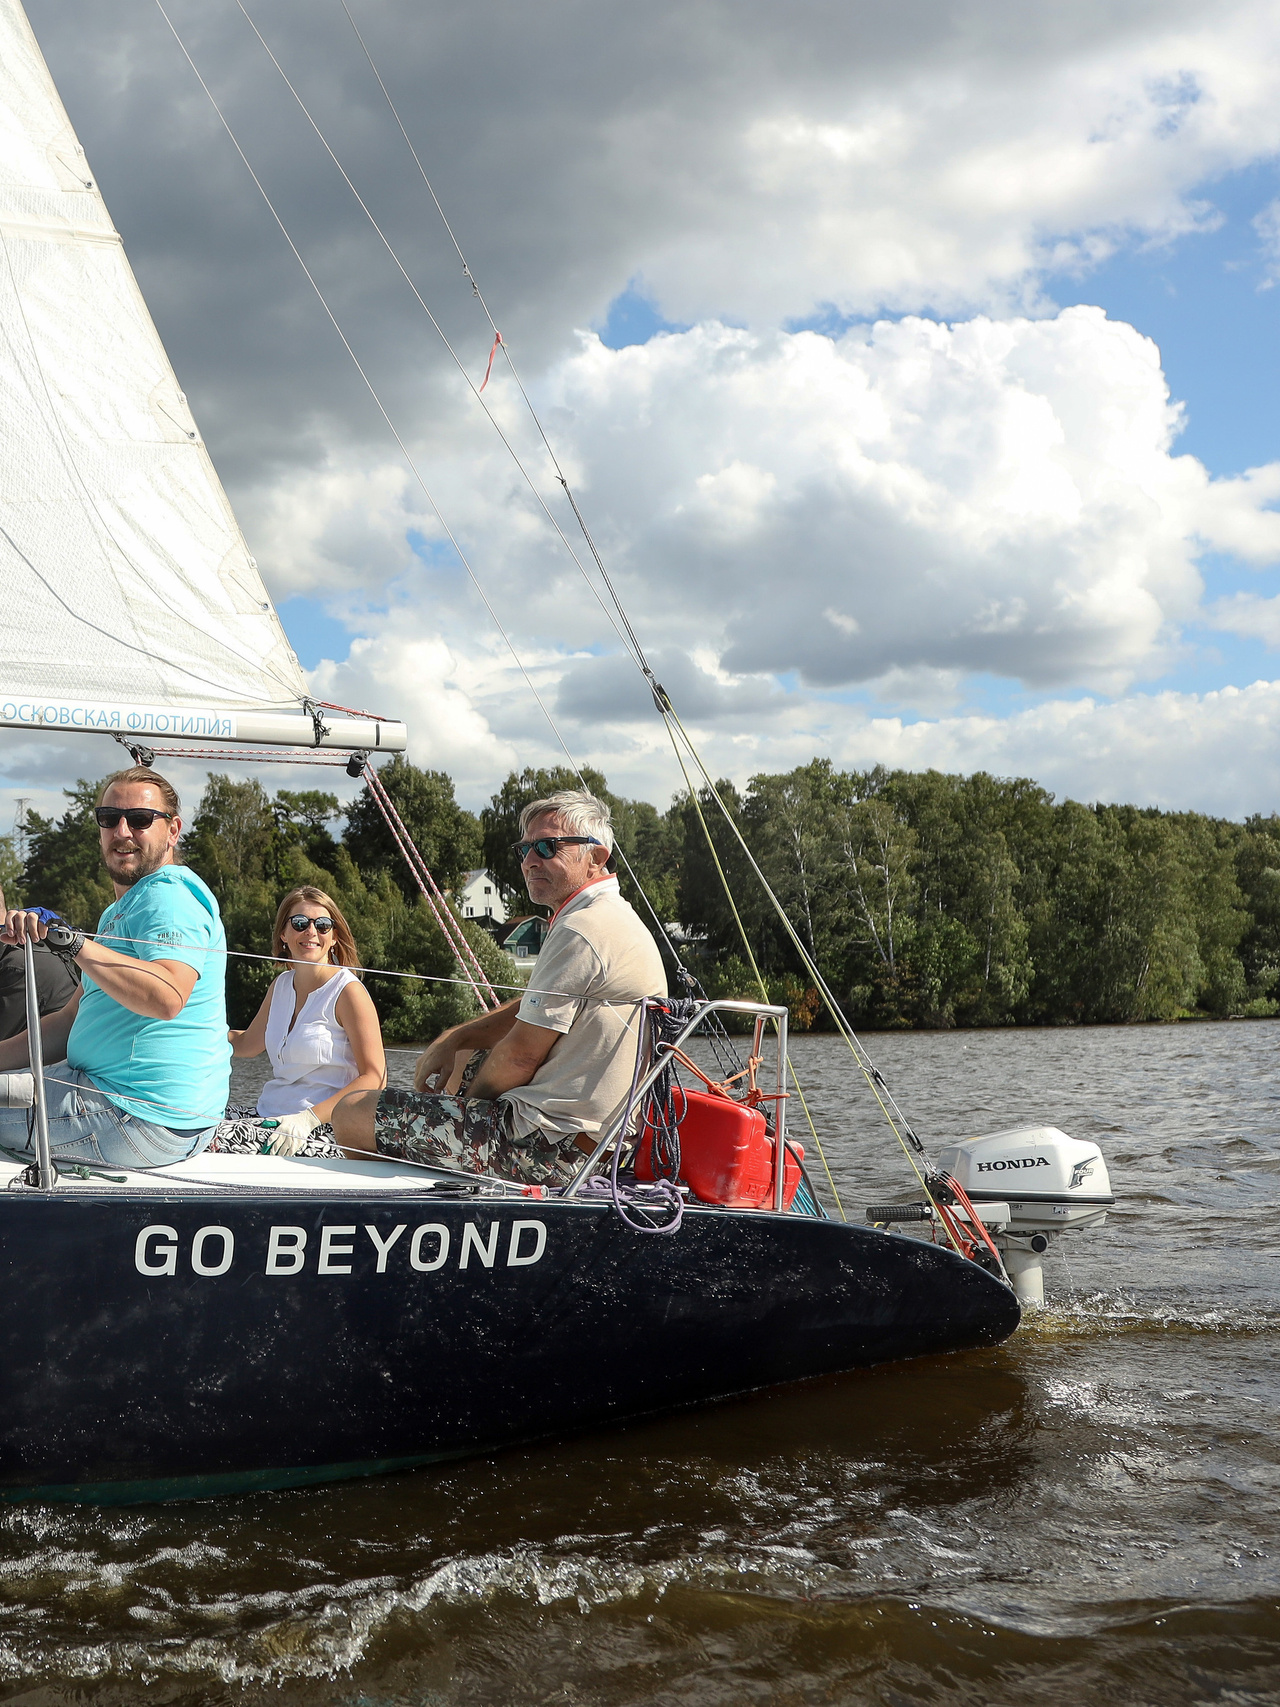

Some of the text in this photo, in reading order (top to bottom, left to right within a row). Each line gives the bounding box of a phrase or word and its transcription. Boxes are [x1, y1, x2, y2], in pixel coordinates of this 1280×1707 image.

[126, 712, 232, 736] ФЛОТИЛИЯ
[977, 1157, 1051, 1172] HONDA
[134, 1219, 548, 1277] GO BEYOND
